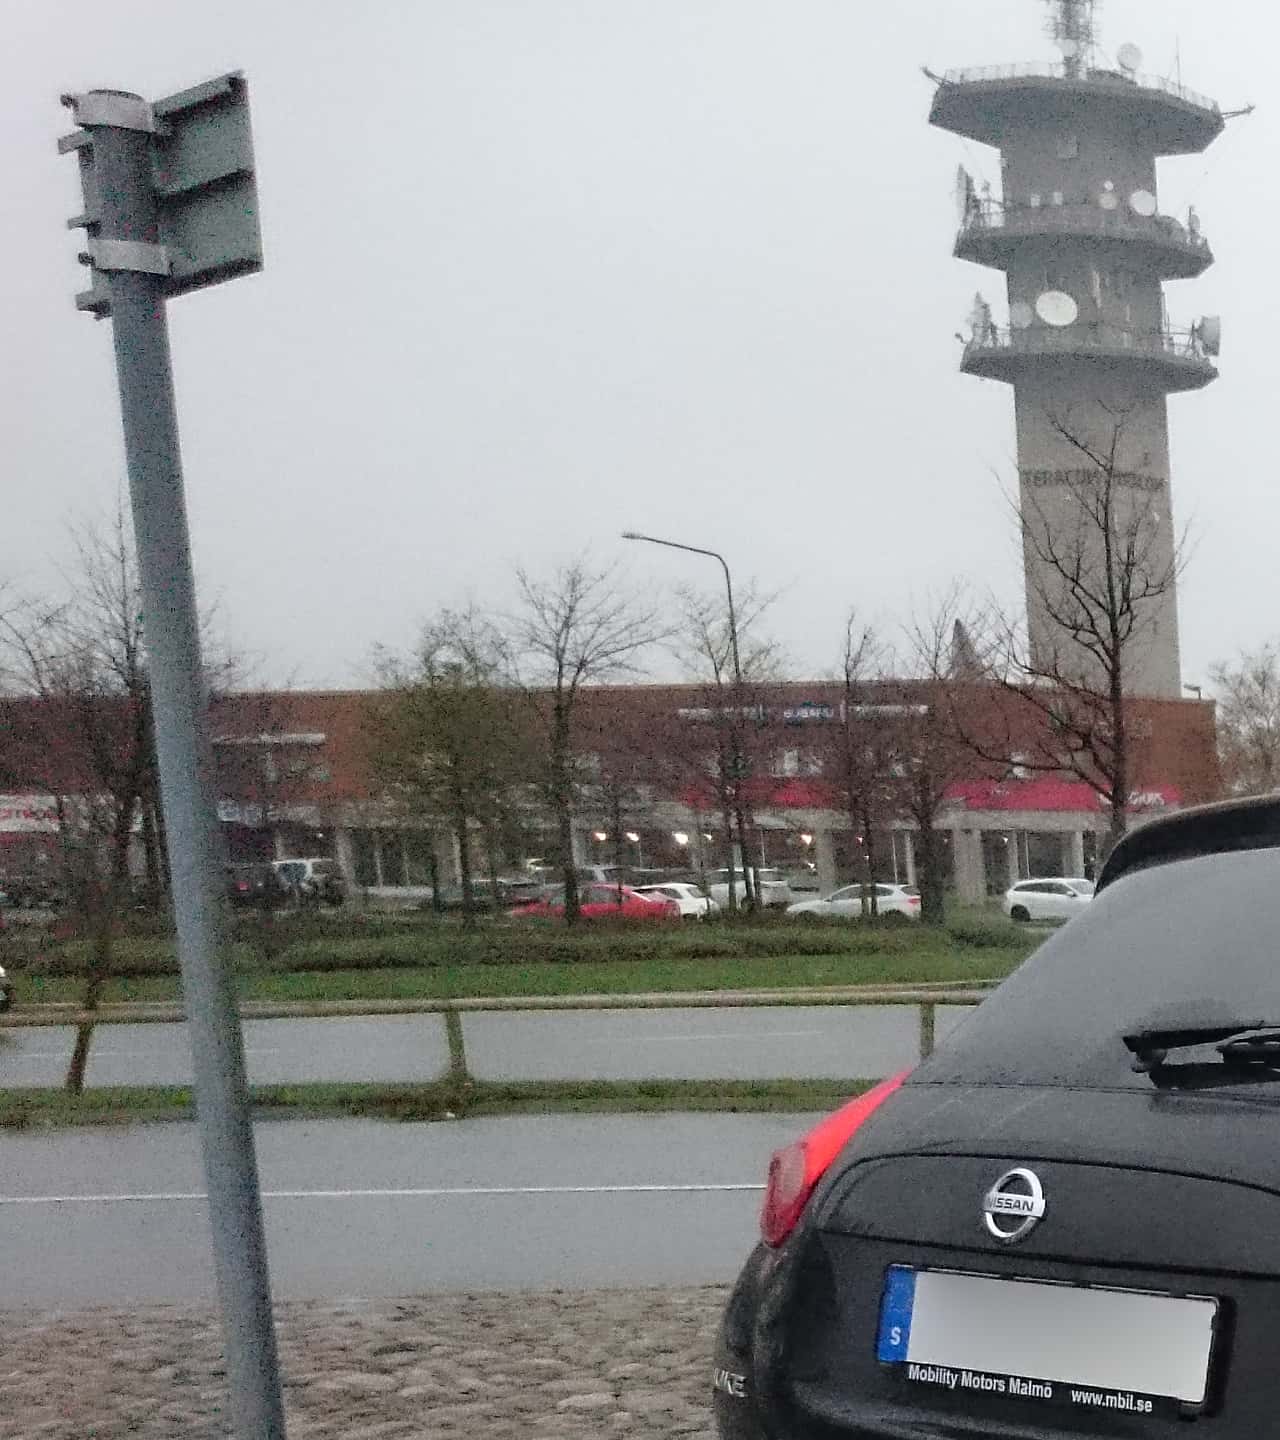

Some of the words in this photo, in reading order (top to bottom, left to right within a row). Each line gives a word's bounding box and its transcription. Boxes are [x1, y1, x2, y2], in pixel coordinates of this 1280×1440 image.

[890, 1327, 901, 1345] S
[908, 1364, 958, 1389] Mobility
[961, 1371, 1006, 1392] Motors
[1071, 1389, 1153, 1413] www.mbil.se
